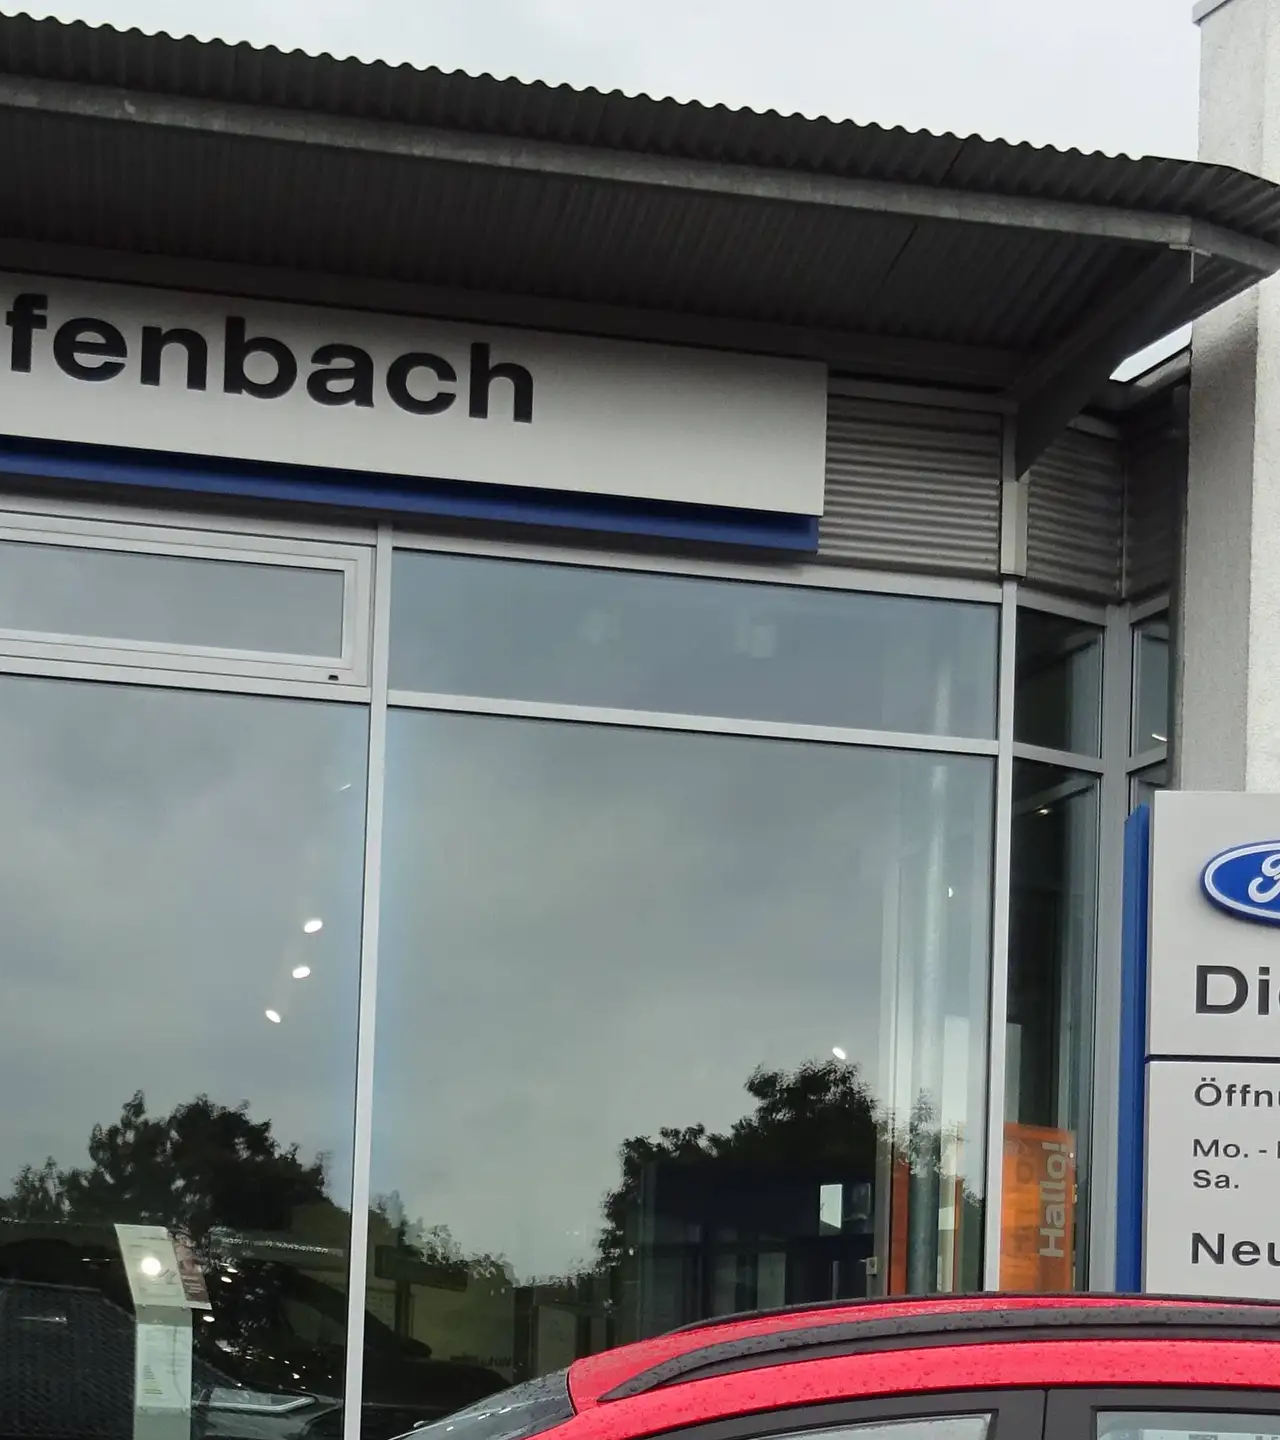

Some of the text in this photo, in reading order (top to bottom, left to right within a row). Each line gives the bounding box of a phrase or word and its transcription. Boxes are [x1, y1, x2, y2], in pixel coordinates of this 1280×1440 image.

[1193, 1138, 1249, 1159] Mo.
[1193, 1169, 1239, 1189] Sa.
[1040, 1142, 1068, 1258] Hallo!
